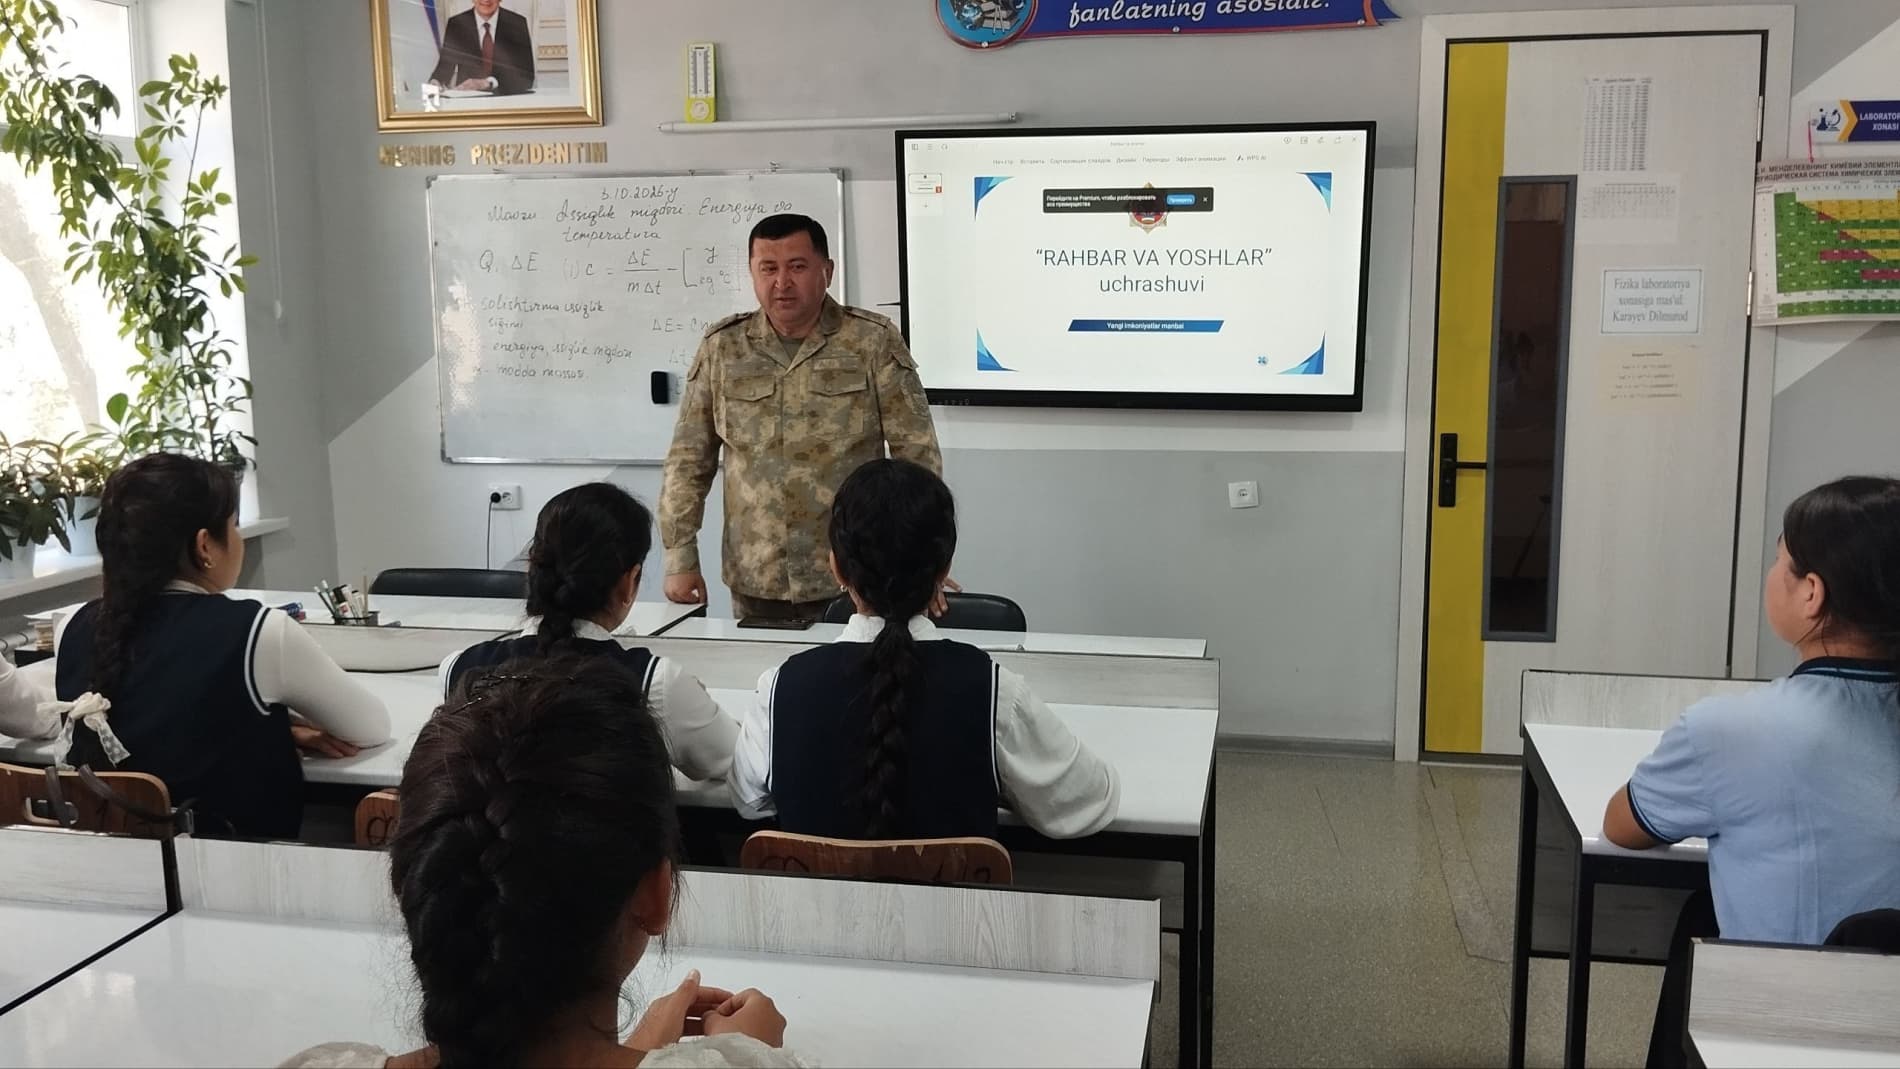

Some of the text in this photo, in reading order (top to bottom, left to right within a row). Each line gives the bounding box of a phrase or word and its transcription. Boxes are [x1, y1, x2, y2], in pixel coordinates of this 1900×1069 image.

[1069, 0, 1206, 28] fanlarning
[1872, 122, 1899, 131] XONASI
[471, 142, 608, 167] PREZIDENTIM
[1133, 249, 1159, 266] VA
[1100, 275, 1205, 292] uchrashuvi
[1614, 277, 1690, 292] Fizika laboratoriya
[1106, 321, 1124, 331] Yangi
[1161, 322, 1185, 330] manbai
